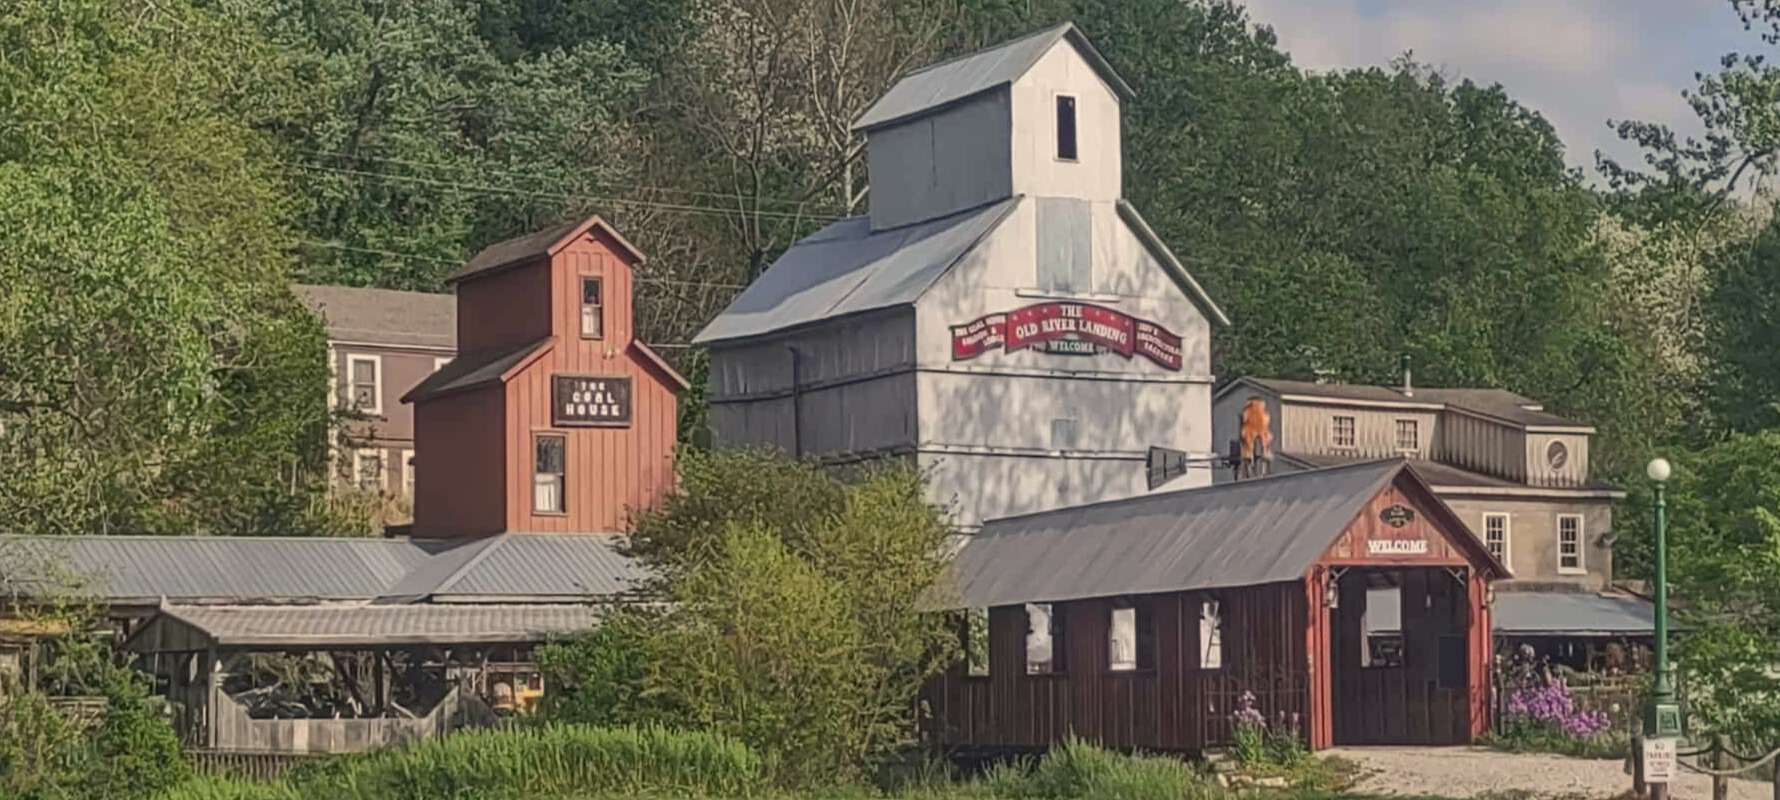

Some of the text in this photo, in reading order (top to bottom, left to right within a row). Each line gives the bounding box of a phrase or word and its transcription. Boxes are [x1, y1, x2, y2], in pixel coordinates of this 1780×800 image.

[1061, 304, 1083, 317] THE
[1015, 323, 1038, 339] OLD
[1042, 318, 1076, 332] RIVER
[1079, 319, 1127, 345] LANDING
[1049, 340, 1095, 352] WELCOME
[581, 381, 605, 391] THE
[572, 391, 615, 404] COAL
[566, 403, 620, 416] HOUSE
[1367, 539, 1428, 554] WELCOME
